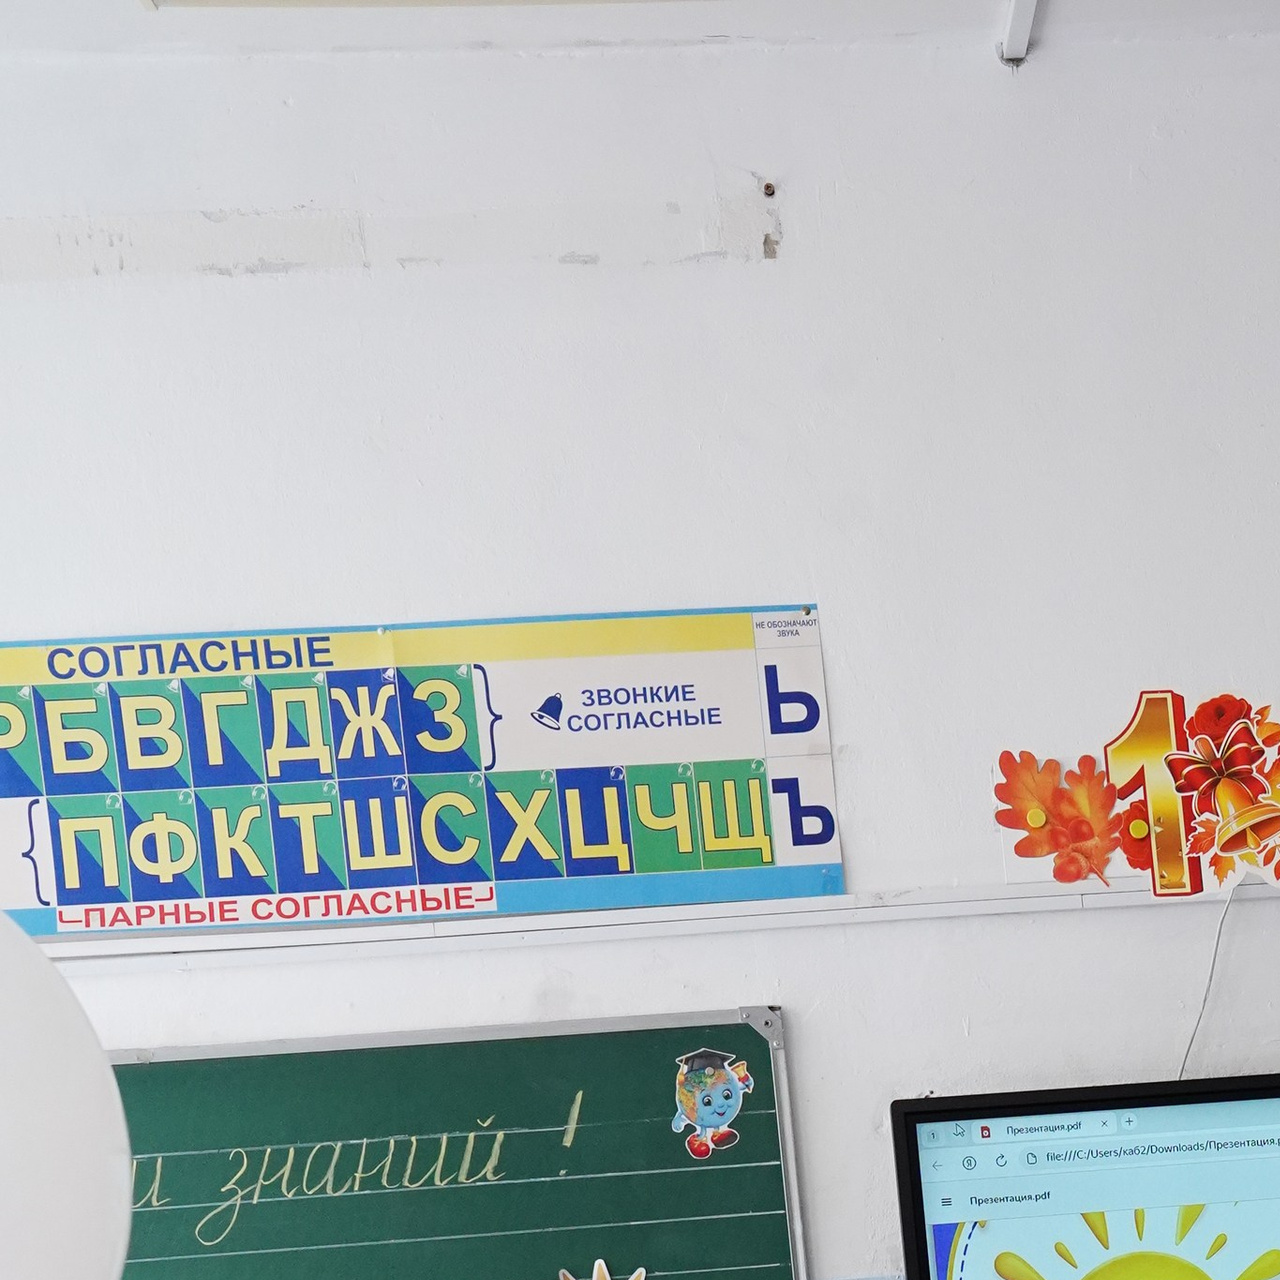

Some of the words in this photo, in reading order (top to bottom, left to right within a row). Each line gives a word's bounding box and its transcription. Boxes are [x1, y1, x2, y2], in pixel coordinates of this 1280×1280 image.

[755, 621, 765, 629] НЕ
[767, 618, 817, 629] ОБОЗНАЧАЮТ
[777, 629, 800, 638] ЗВУКА
[47, 636, 335, 680] СОГЛАСНЫЕ
[581, 684, 697, 707] ЗВОНКИЕ
[765, 663, 822, 736] Ь
[568, 708, 723, 732] СОГЛАСНЫЕ
[771, 777, 837, 847] Ъ
[82, 899, 241, 929] ПАРНЫЕ
[251, 887, 476, 922] СОГЛАСНЫЕ
[1007, 1121, 1082, 1135] Презентация.pdf
[196, 1115, 505, 1246] знаний
[970, 1190, 1051, 1206] Презентация.pdf
